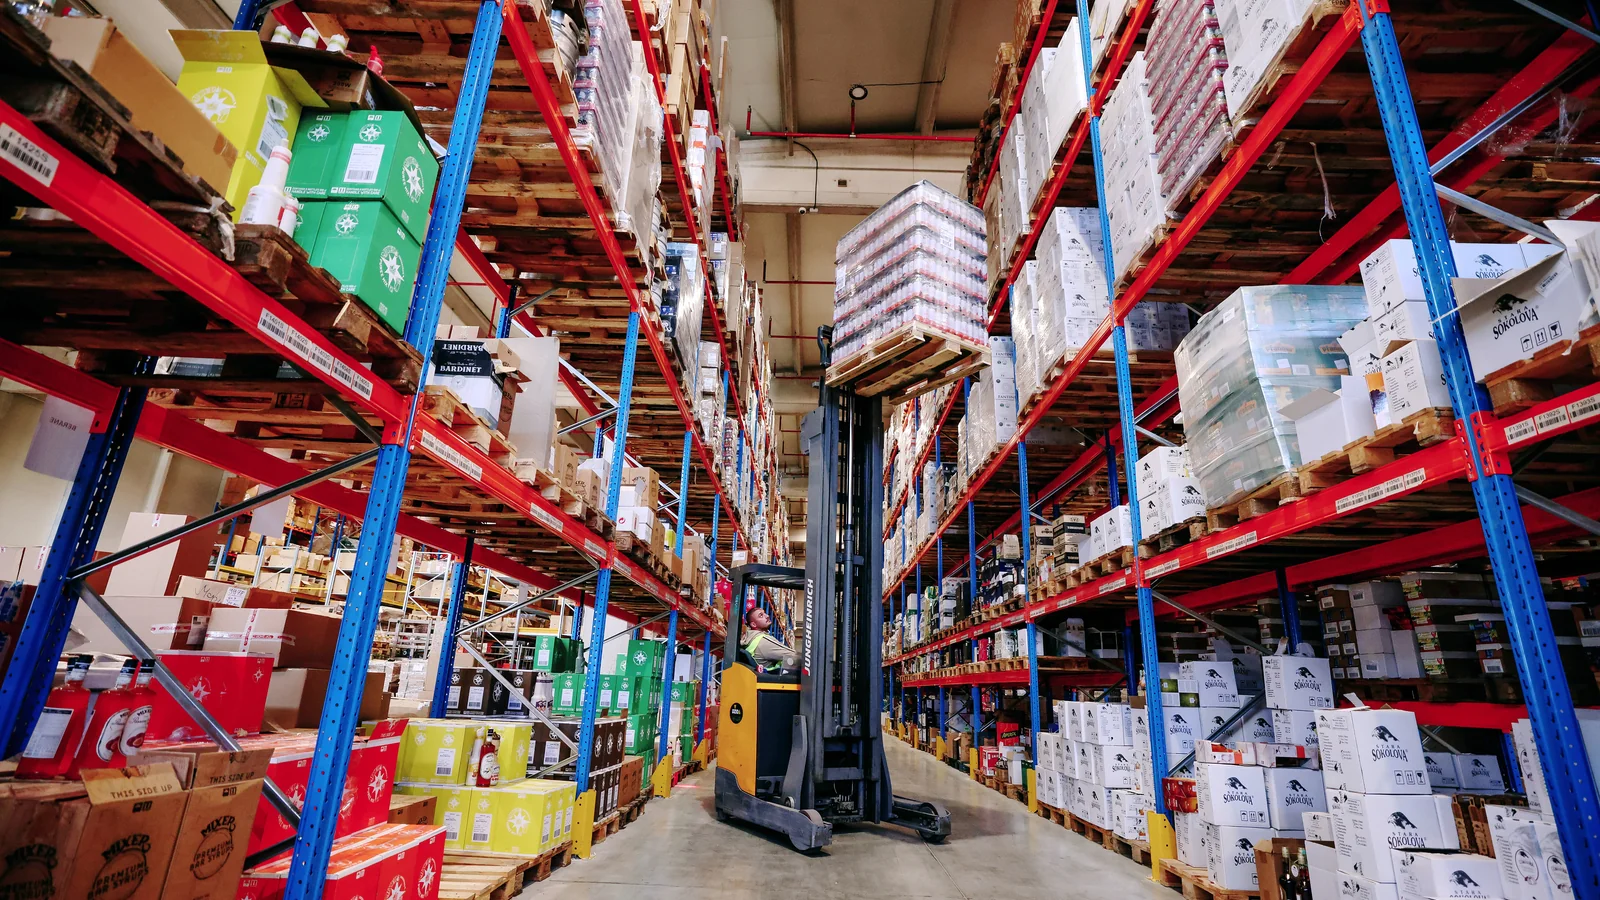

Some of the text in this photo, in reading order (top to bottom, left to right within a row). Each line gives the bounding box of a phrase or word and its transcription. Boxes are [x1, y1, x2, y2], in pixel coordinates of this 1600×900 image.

[265, 312, 284, 329] F1401S
[1498, 306, 1531, 322] STARA
[1492, 307, 1539, 340] SOKOLOVA
[291, 329, 309, 346] F1402S
[442, 343, 484, 352] BARDINET
[440, 365, 482, 373] BARDINET
[1571, 397, 1596, 410] F1393S
[1538, 408, 1561, 420] F1392S
[1508, 421, 1529, 433] F1391S
[802, 578, 814, 677] JUNGHEINRICH
[1294, 681, 1321, 692] SOKOLOVA
[1371, 749, 1408, 762] SOKOLOVA
[210, 771, 255, 783] THIS SIDE UP
[110, 784, 173, 799] THIS SIDE UP
[1223, 794, 1253, 805] SOKOLOVA
[1285, 796, 1313, 808] SOKOLOVA
[200, 815, 236, 838] MIXER
[101, 833, 151, 862] MIXER
[195, 839, 233, 860] PREMIUM
[1387, 836, 1426, 849] SOKOLOVA
[5, 843, 58, 870] MIXER
[190, 845, 234, 872] BAR SYRUPS
[95, 862, 146, 888] PREMIUM
[113, 866, 149, 890] SYRUPS
